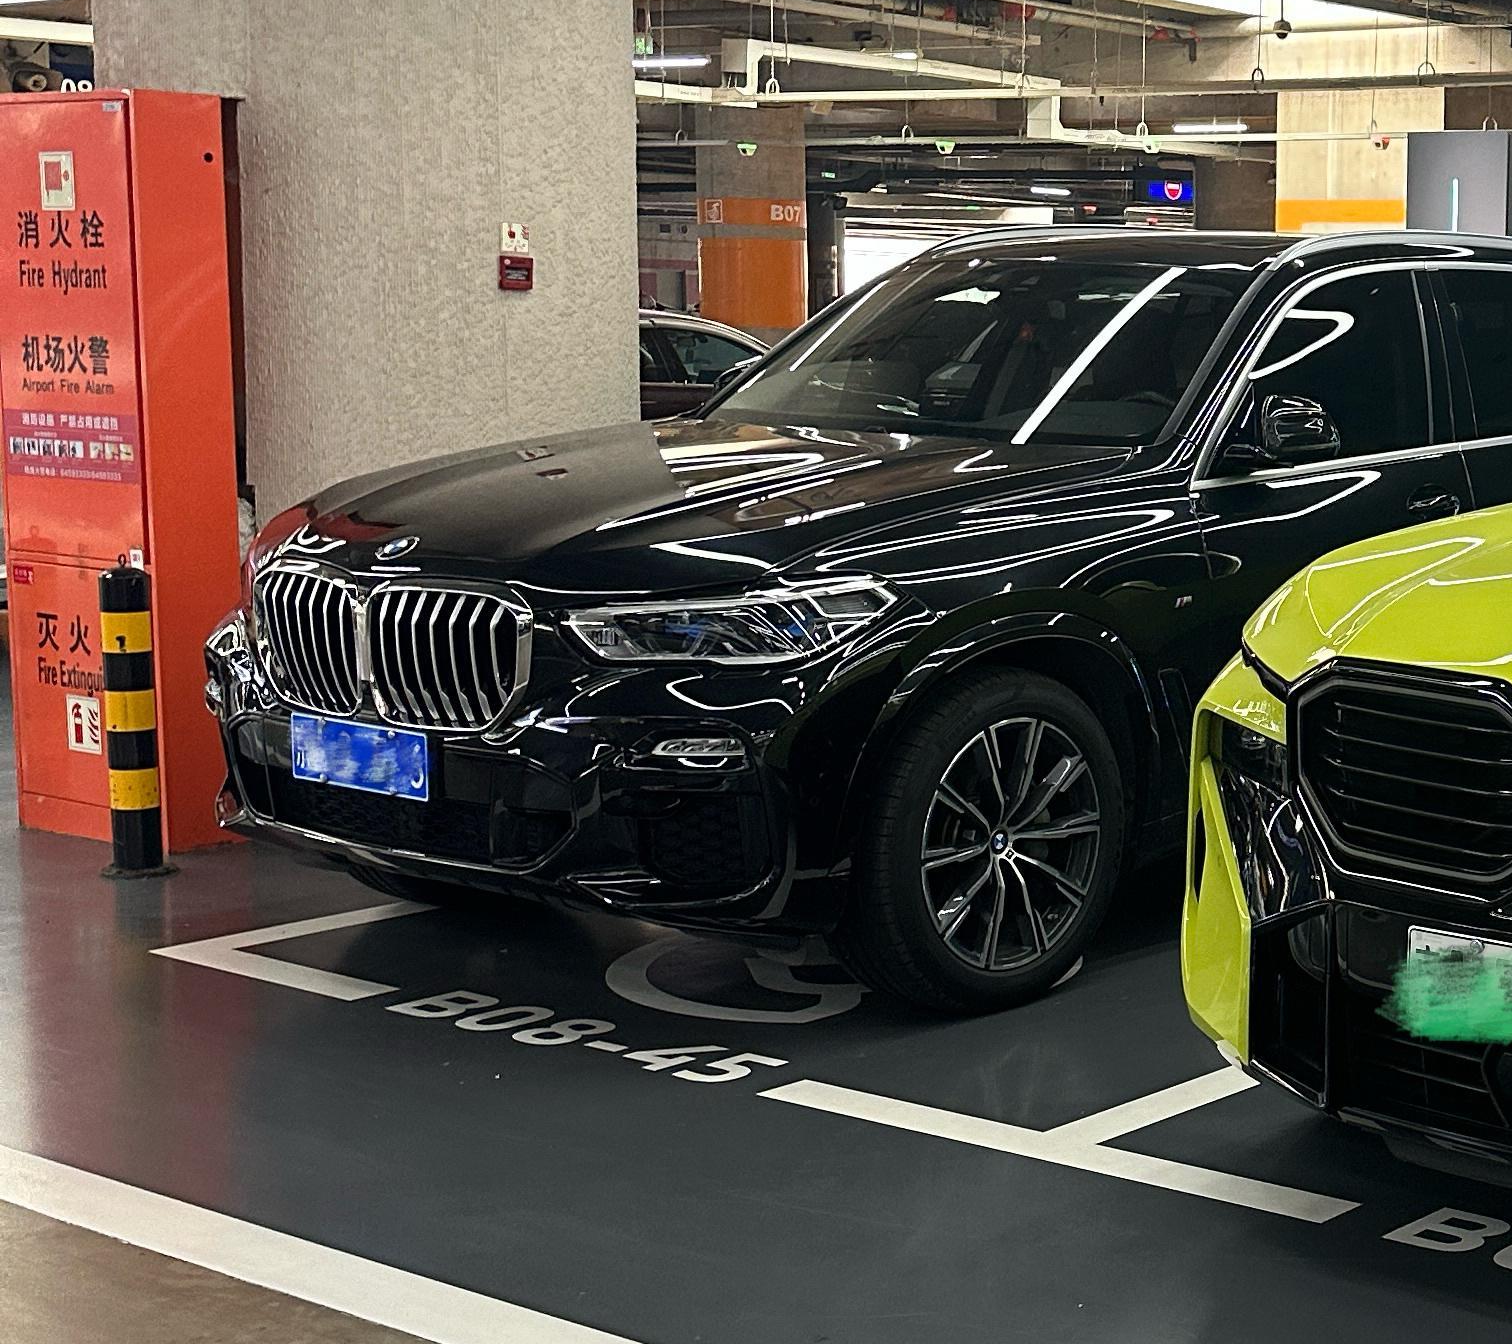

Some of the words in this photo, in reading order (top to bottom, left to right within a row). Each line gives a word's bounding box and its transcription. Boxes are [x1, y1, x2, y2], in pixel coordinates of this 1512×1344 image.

[17, 210, 105, 249] 消火栓
[770, 204, 801, 223] B07
[19, 259, 45, 288] Fire
[51, 259, 108, 296] Hydrant
[22, 334, 110, 376] 机场火警
[21, 377, 55, 394] Airport
[59, 379, 80, 394] Fire
[85, 379, 115, 396] Alarm
[36, 612, 92, 656] 灭火
[37, 656, 58, 686] Fire
[60, 659, 104, 698] Extingui
[384, 990, 790, 1083] B08-45
